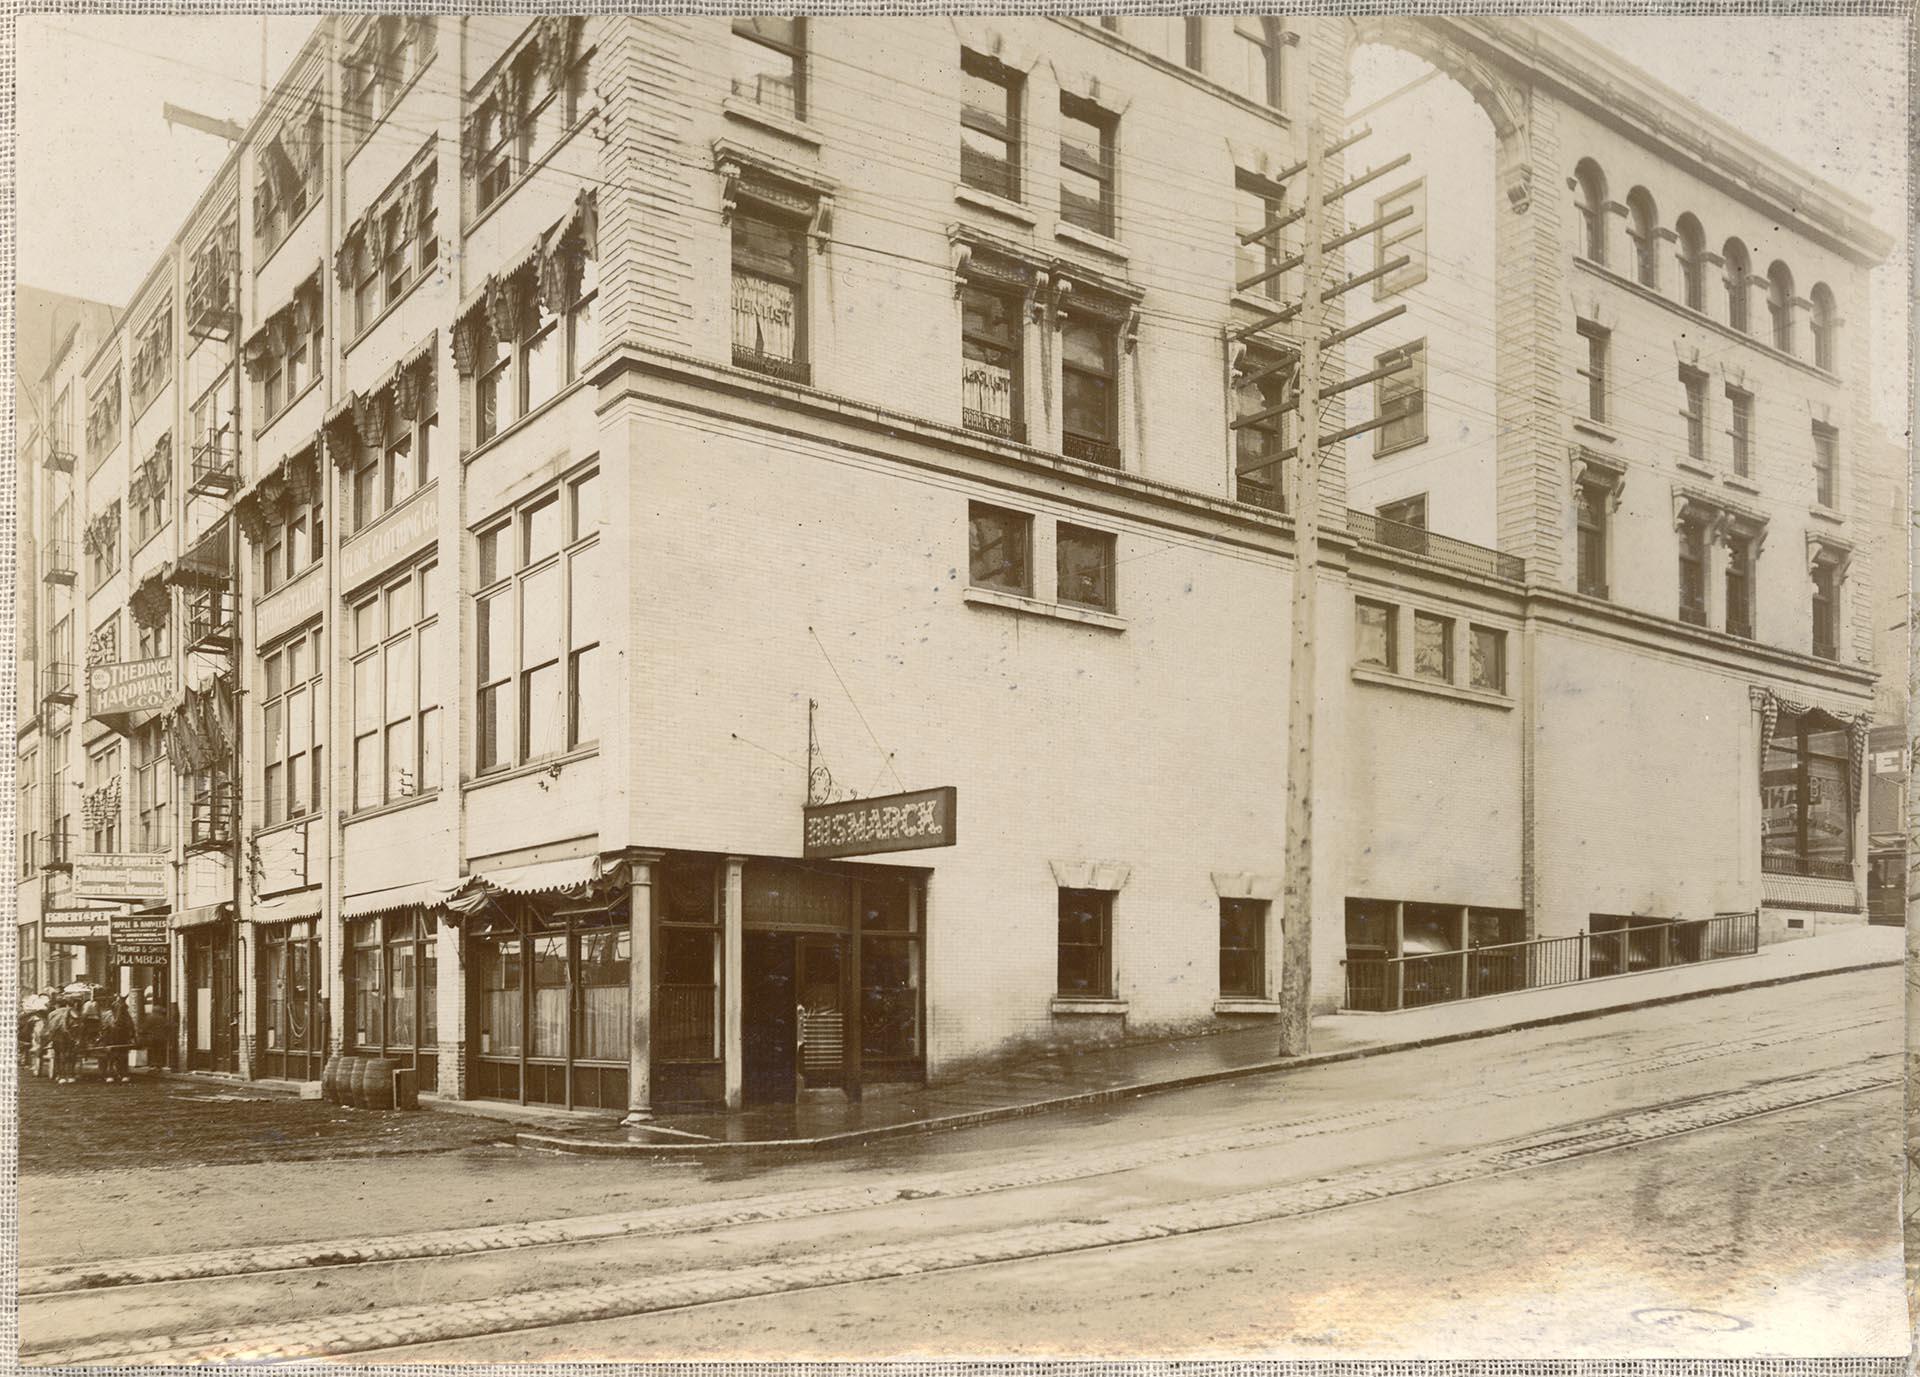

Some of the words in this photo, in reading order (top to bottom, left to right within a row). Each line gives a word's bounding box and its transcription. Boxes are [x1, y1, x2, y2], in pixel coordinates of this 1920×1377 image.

[110, 660, 172, 686] THEDINGA
[97, 676, 173, 713] HARDWARE
[808, 799, 942, 848] BISMARCK
[117, 954, 168, 965] PLUMBERS
